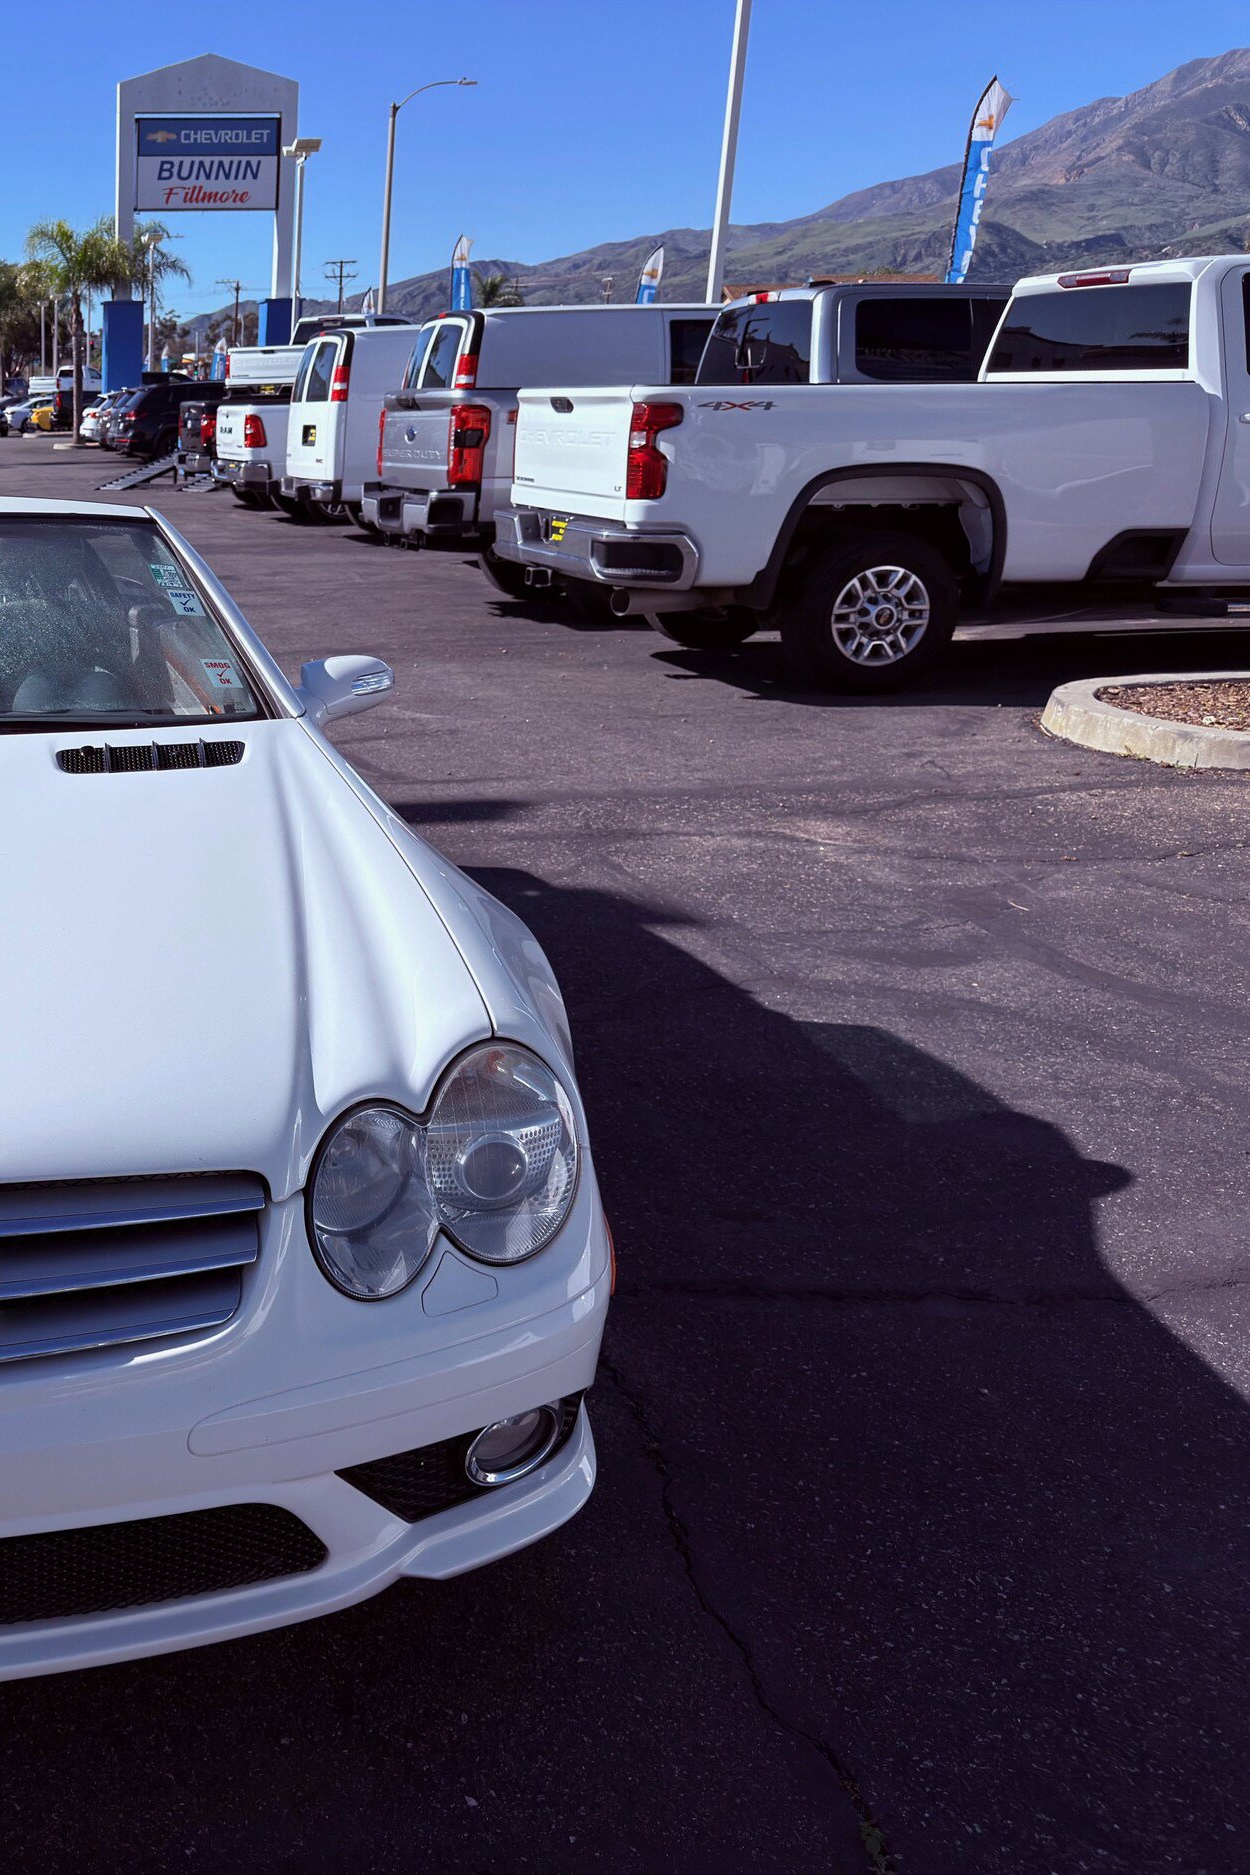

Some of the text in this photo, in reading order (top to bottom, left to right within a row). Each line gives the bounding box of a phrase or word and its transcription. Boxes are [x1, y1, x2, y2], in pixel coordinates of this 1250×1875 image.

[180, 129, 271, 143] CHEVROLET
[157, 160, 261, 181] BUNNIN
[162, 184, 251, 205] Fillmore
[220, 427, 233, 435] RAM
